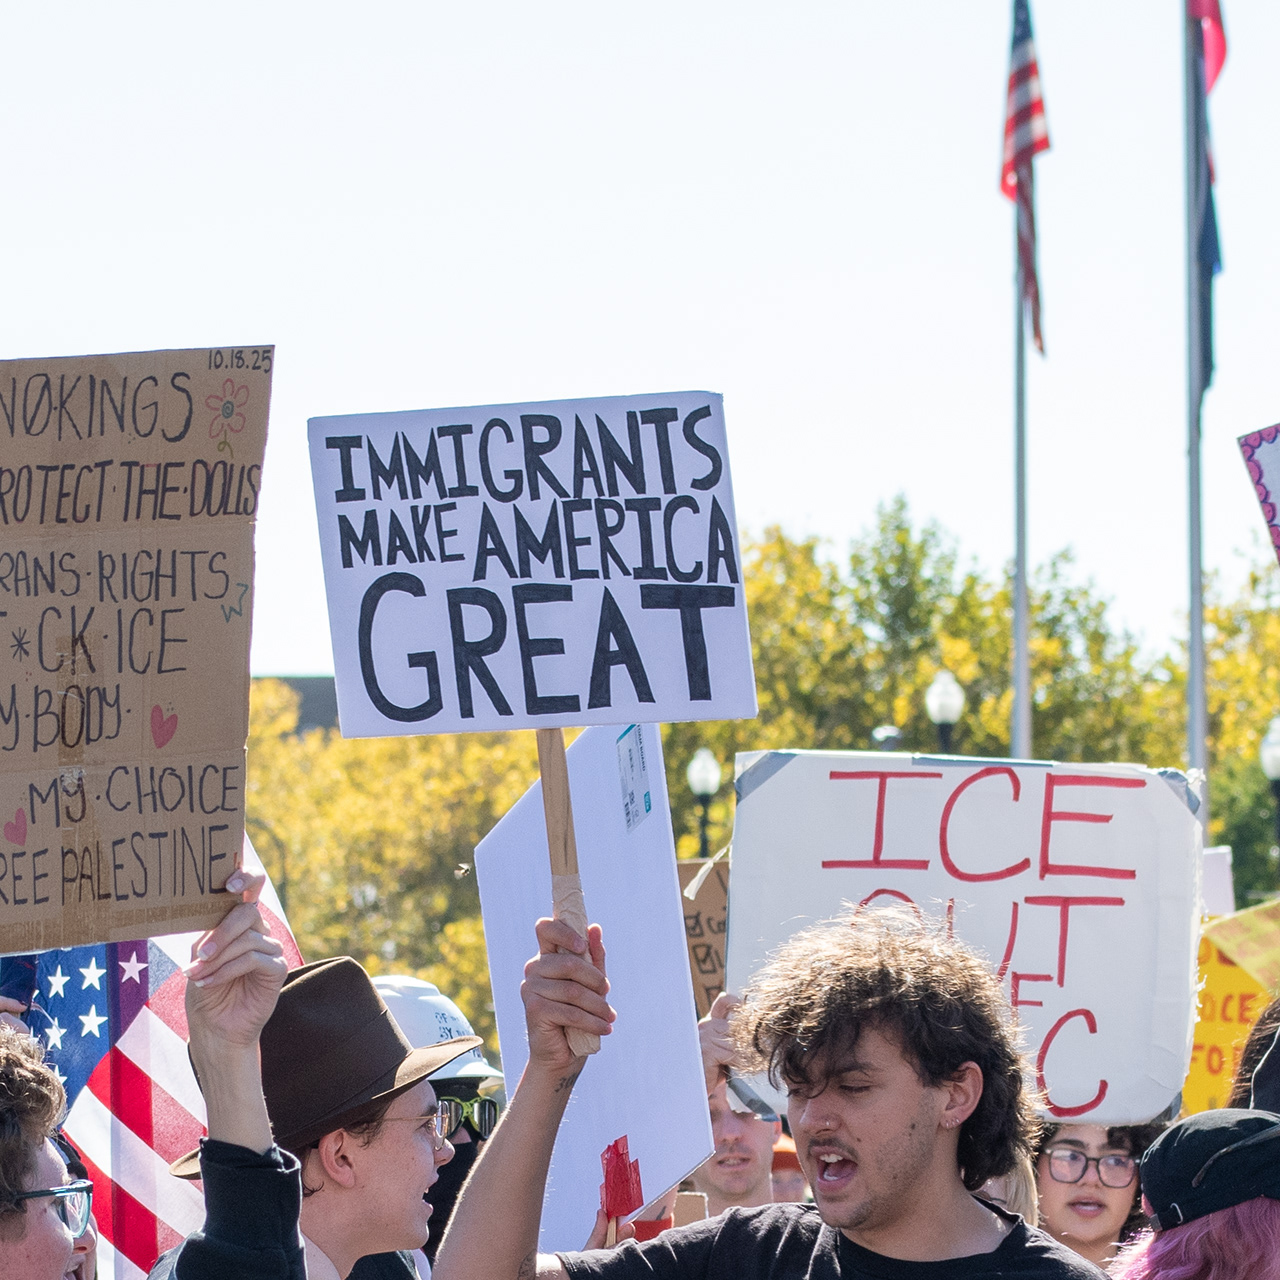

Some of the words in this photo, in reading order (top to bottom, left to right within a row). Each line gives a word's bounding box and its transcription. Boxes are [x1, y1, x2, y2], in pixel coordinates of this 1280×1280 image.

[208, 349, 272, 374] 10.18.25
[324, 404, 723, 504] IMMIGRANTS
[337, 501, 466, 569] MAKE
[471, 494, 740, 584] AMERICA
[358, 571, 736, 724] GREAT
[61, 824, 230, 907] PALESTINE
[821, 765, 1148, 883] ICE
